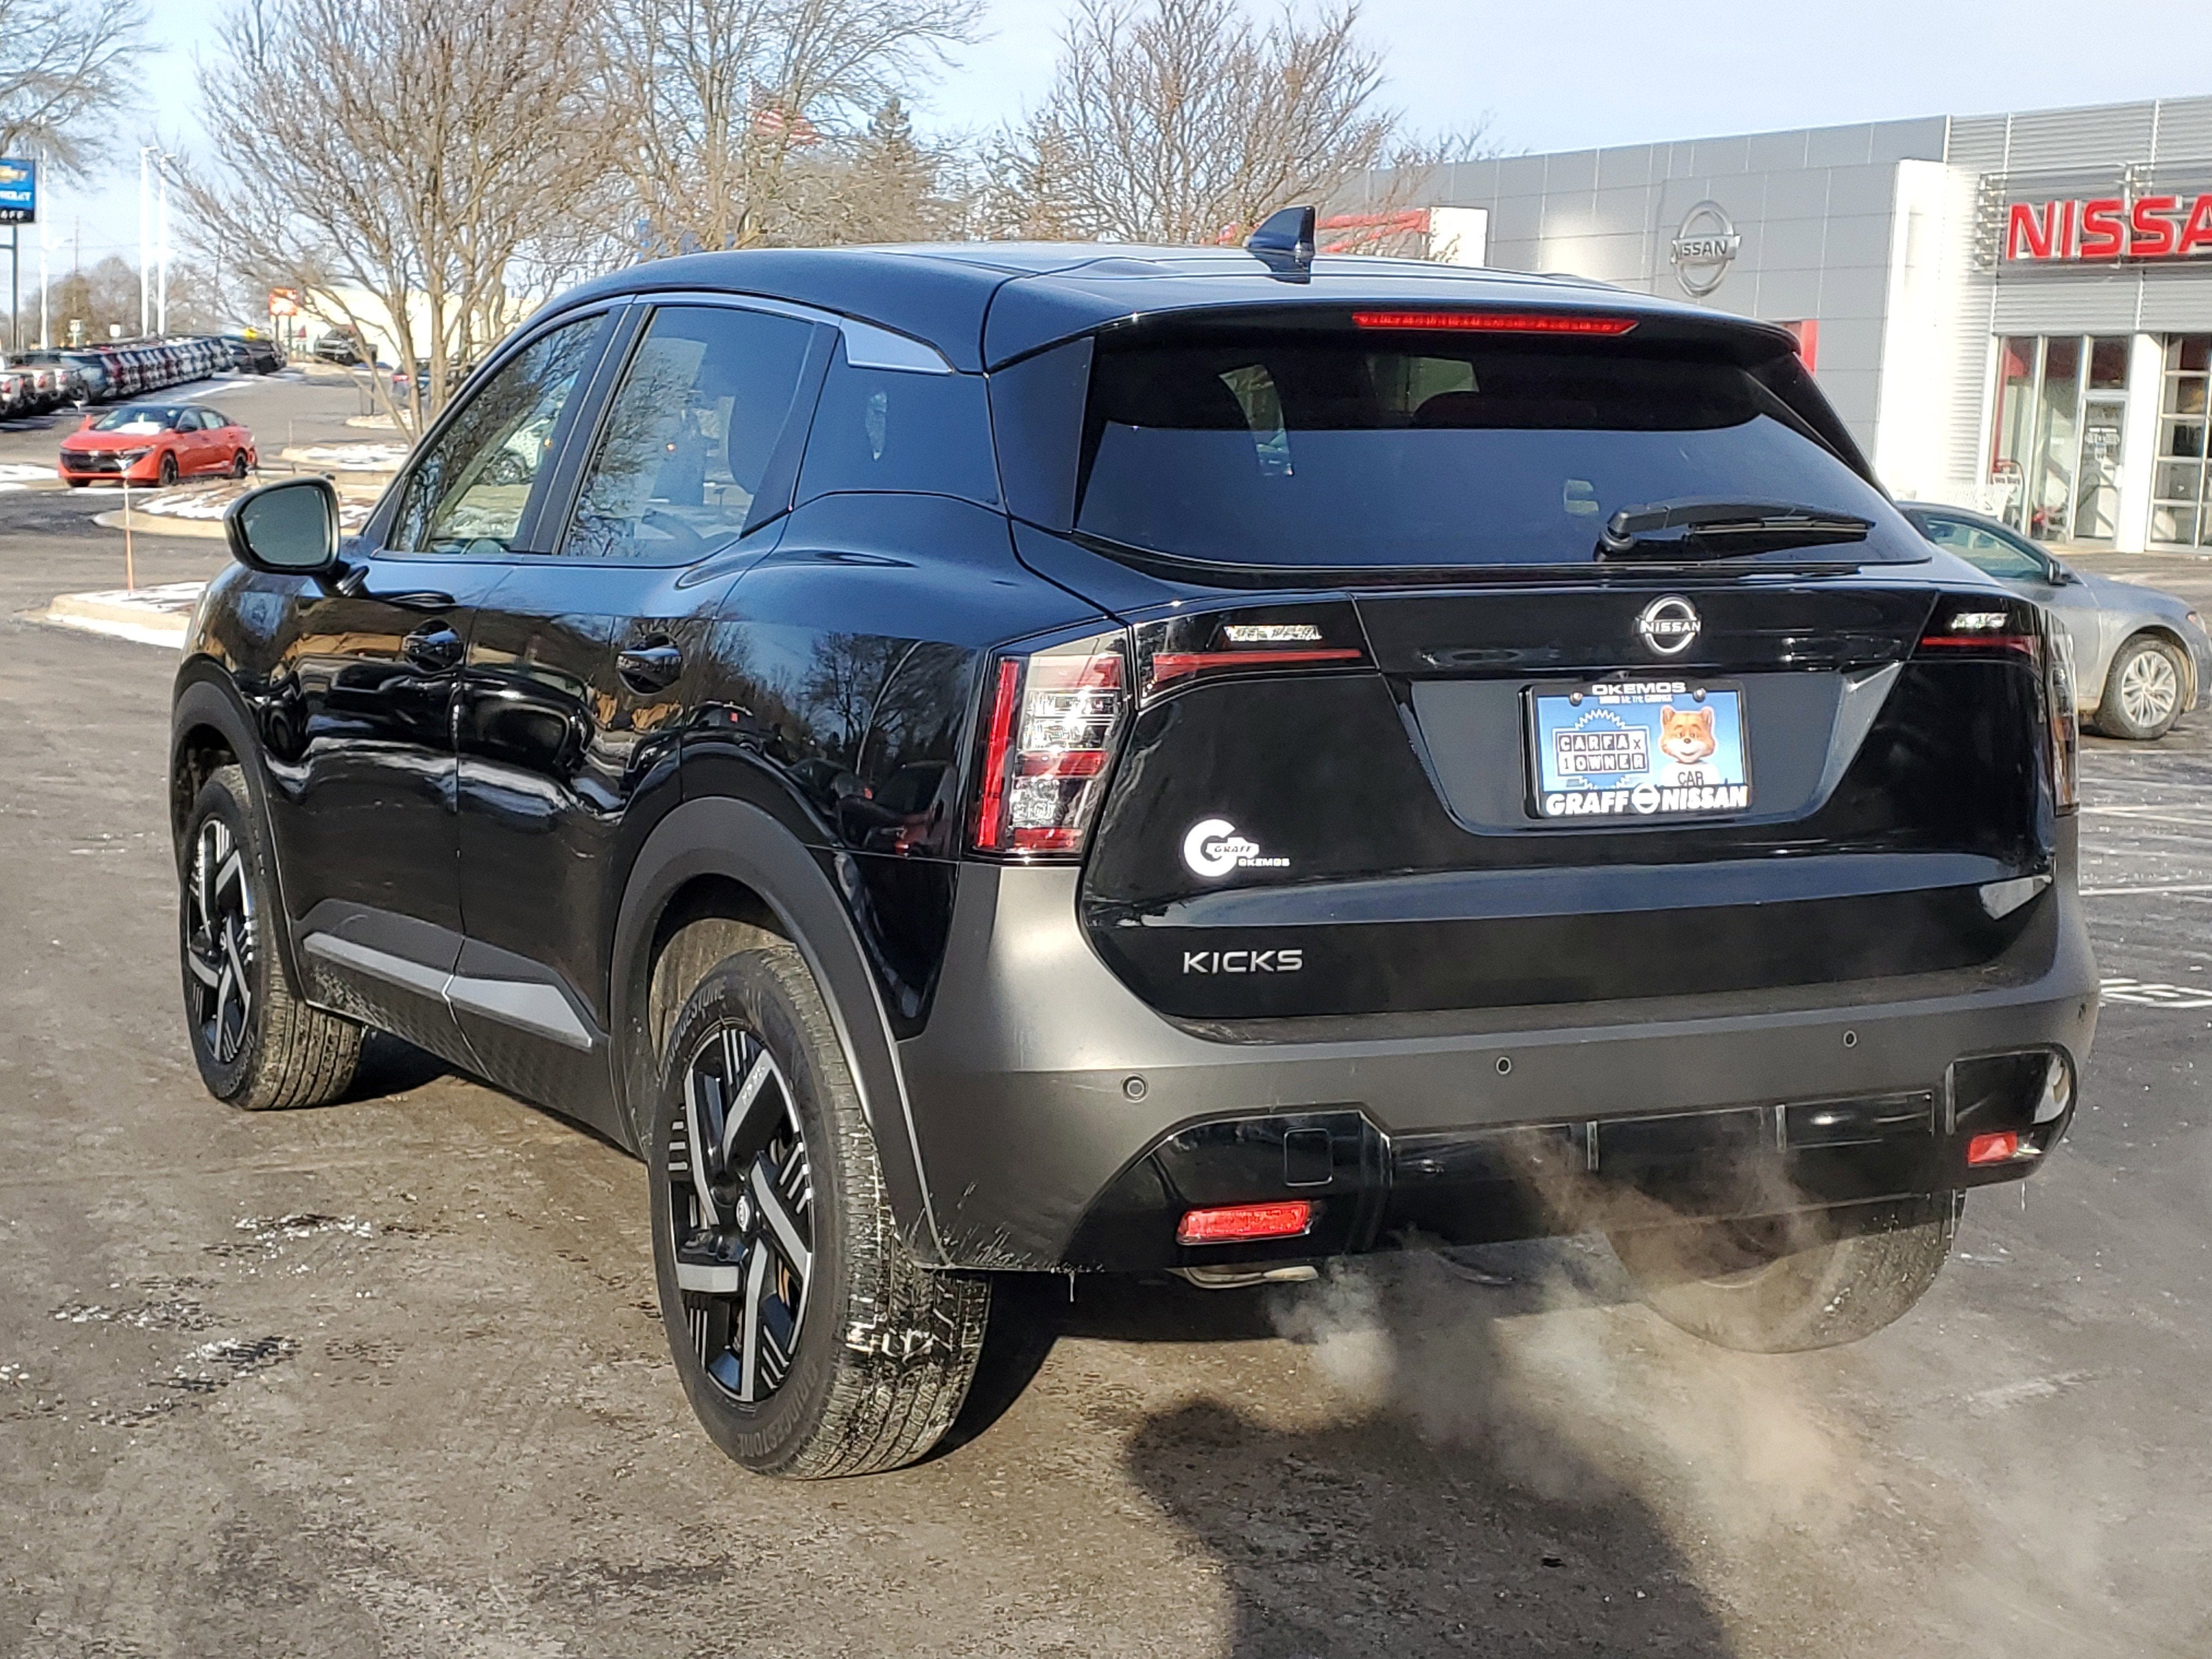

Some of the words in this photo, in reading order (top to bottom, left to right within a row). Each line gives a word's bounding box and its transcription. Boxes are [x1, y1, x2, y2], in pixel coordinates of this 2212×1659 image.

[2006, 193, 2212, 260] NISSA
[1640, 620, 1701, 634] NISSAN
[1592, 682, 1686, 695] OKEMOS
[1559, 733, 1641, 751] CARFAX
[1564, 758, 1569, 769] 1
[1574, 753, 1646, 771] OWNER
[1678, 771, 1704, 786] CAR
[1545, 790, 1629, 815] GRAFF
[1662, 786, 1747, 811] NISSAN
[1238, 857, 1290, 867] OKEMOS
[1183, 949, 1303, 973] KICKS
